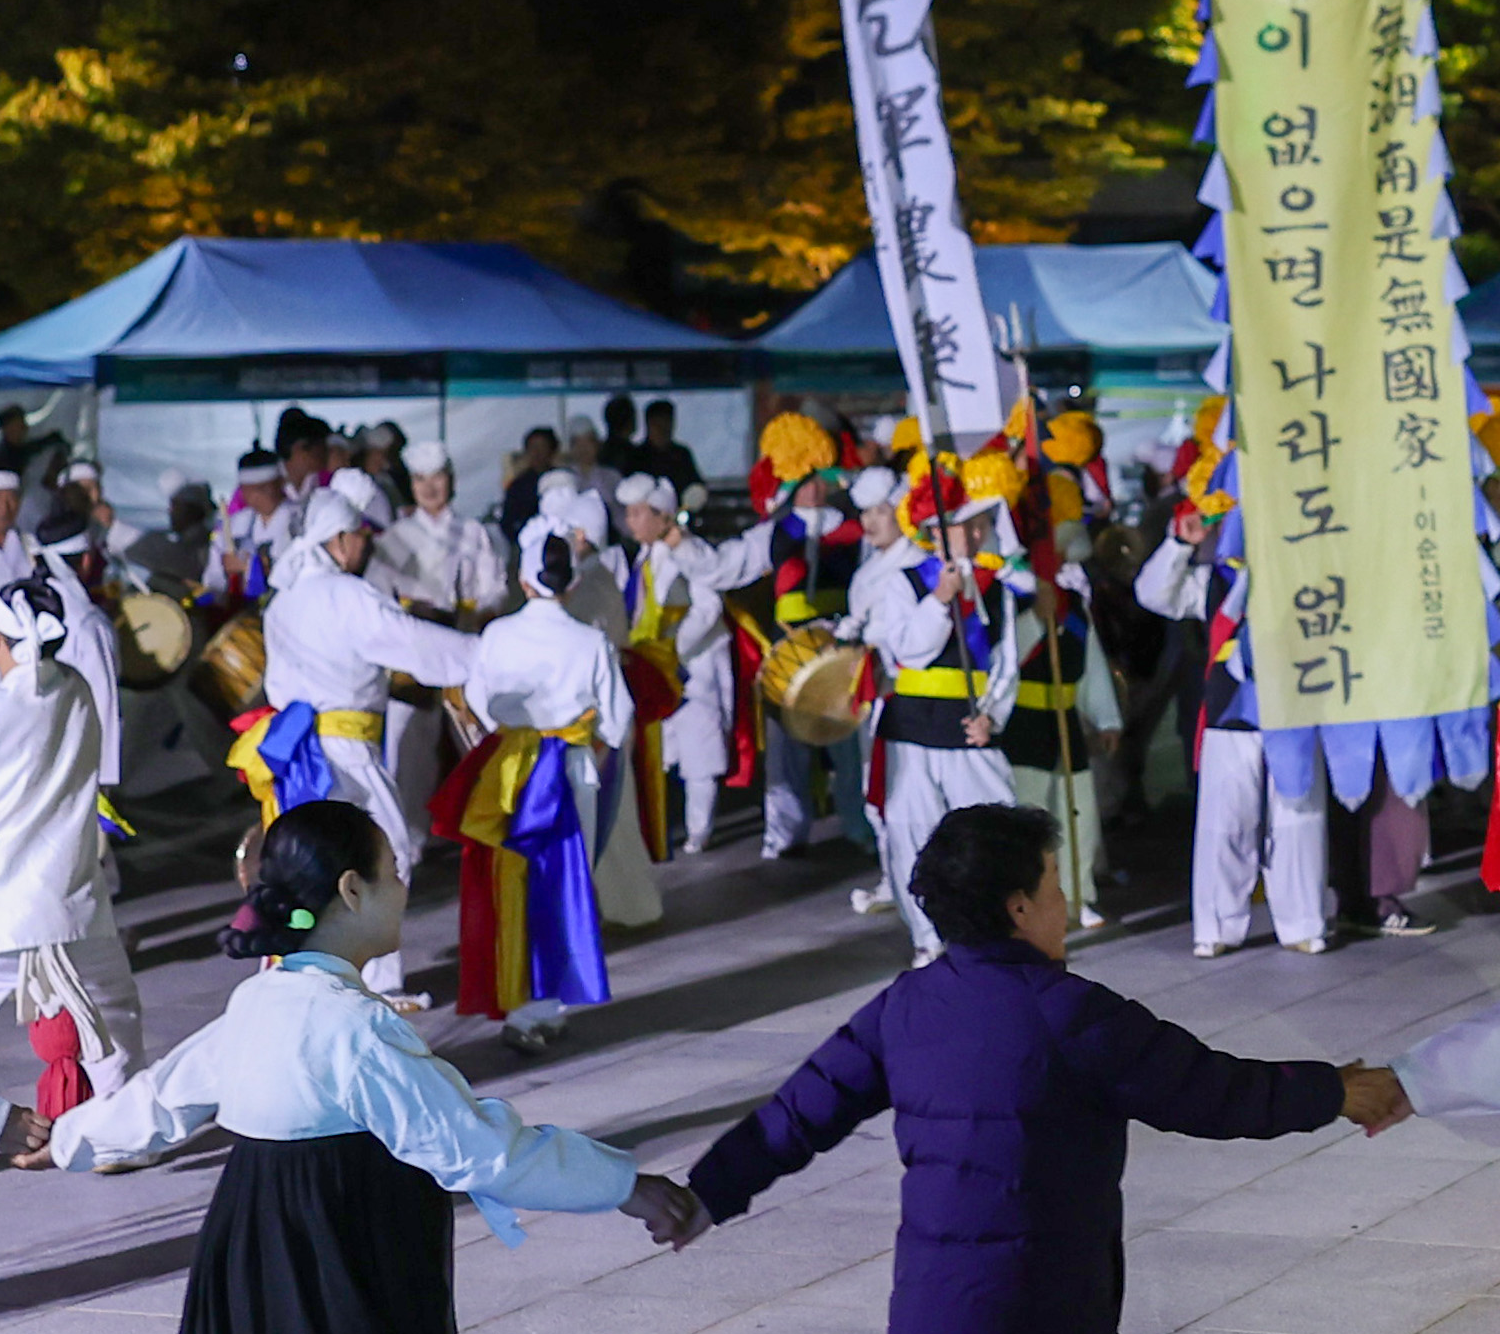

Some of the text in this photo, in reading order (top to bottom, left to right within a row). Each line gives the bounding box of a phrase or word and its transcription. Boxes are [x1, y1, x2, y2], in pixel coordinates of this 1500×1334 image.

[1260, 104, 1329, 308] 없으면
[1270, 340, 1349, 544] 나라도
[1292, 574, 1364, 705] 없다
